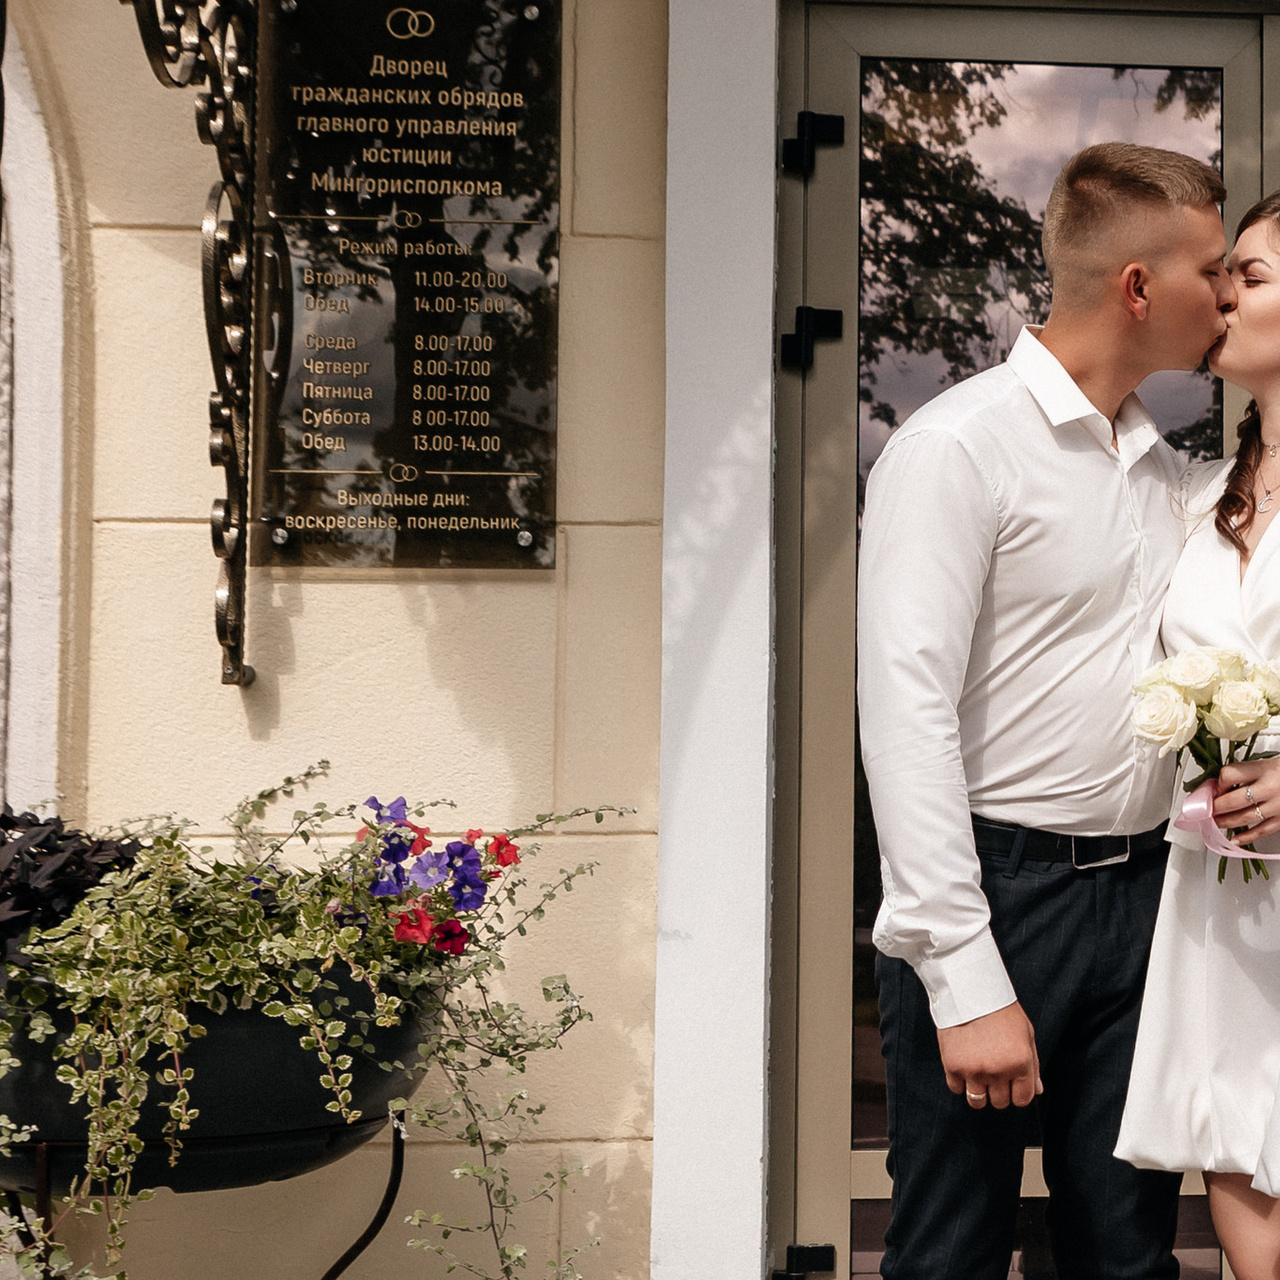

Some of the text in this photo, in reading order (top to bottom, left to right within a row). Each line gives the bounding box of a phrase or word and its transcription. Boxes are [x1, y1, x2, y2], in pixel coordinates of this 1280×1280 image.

[370, 55, 448, 78] Дворец
[292, 86, 524, 109] гражданских обрядов
[297, 116, 517, 138] главного управления
[363, 147, 452, 166] юстиции
[311, 172, 503, 196] Мингорисполкома
[339, 238, 398, 256] Режим
[303, 269, 508, 288] Вторник 11.00-20.00
[303, 295, 505, 313] Обед 14.00-15.00
[304, 333, 493, 352] Среда 8.00-17.00
[303, 359, 491, 378] Четверг 8.00-17.00
[302, 382, 490, 401] Пятница 8.00-17.00
[302, 408, 371, 427] Суббота
[301, 433, 500, 452] Обед 13.00-14.00
[337, 489, 470, 508] Выходные дни:
[285, 515, 520, 532] воскресенье, понедельник
